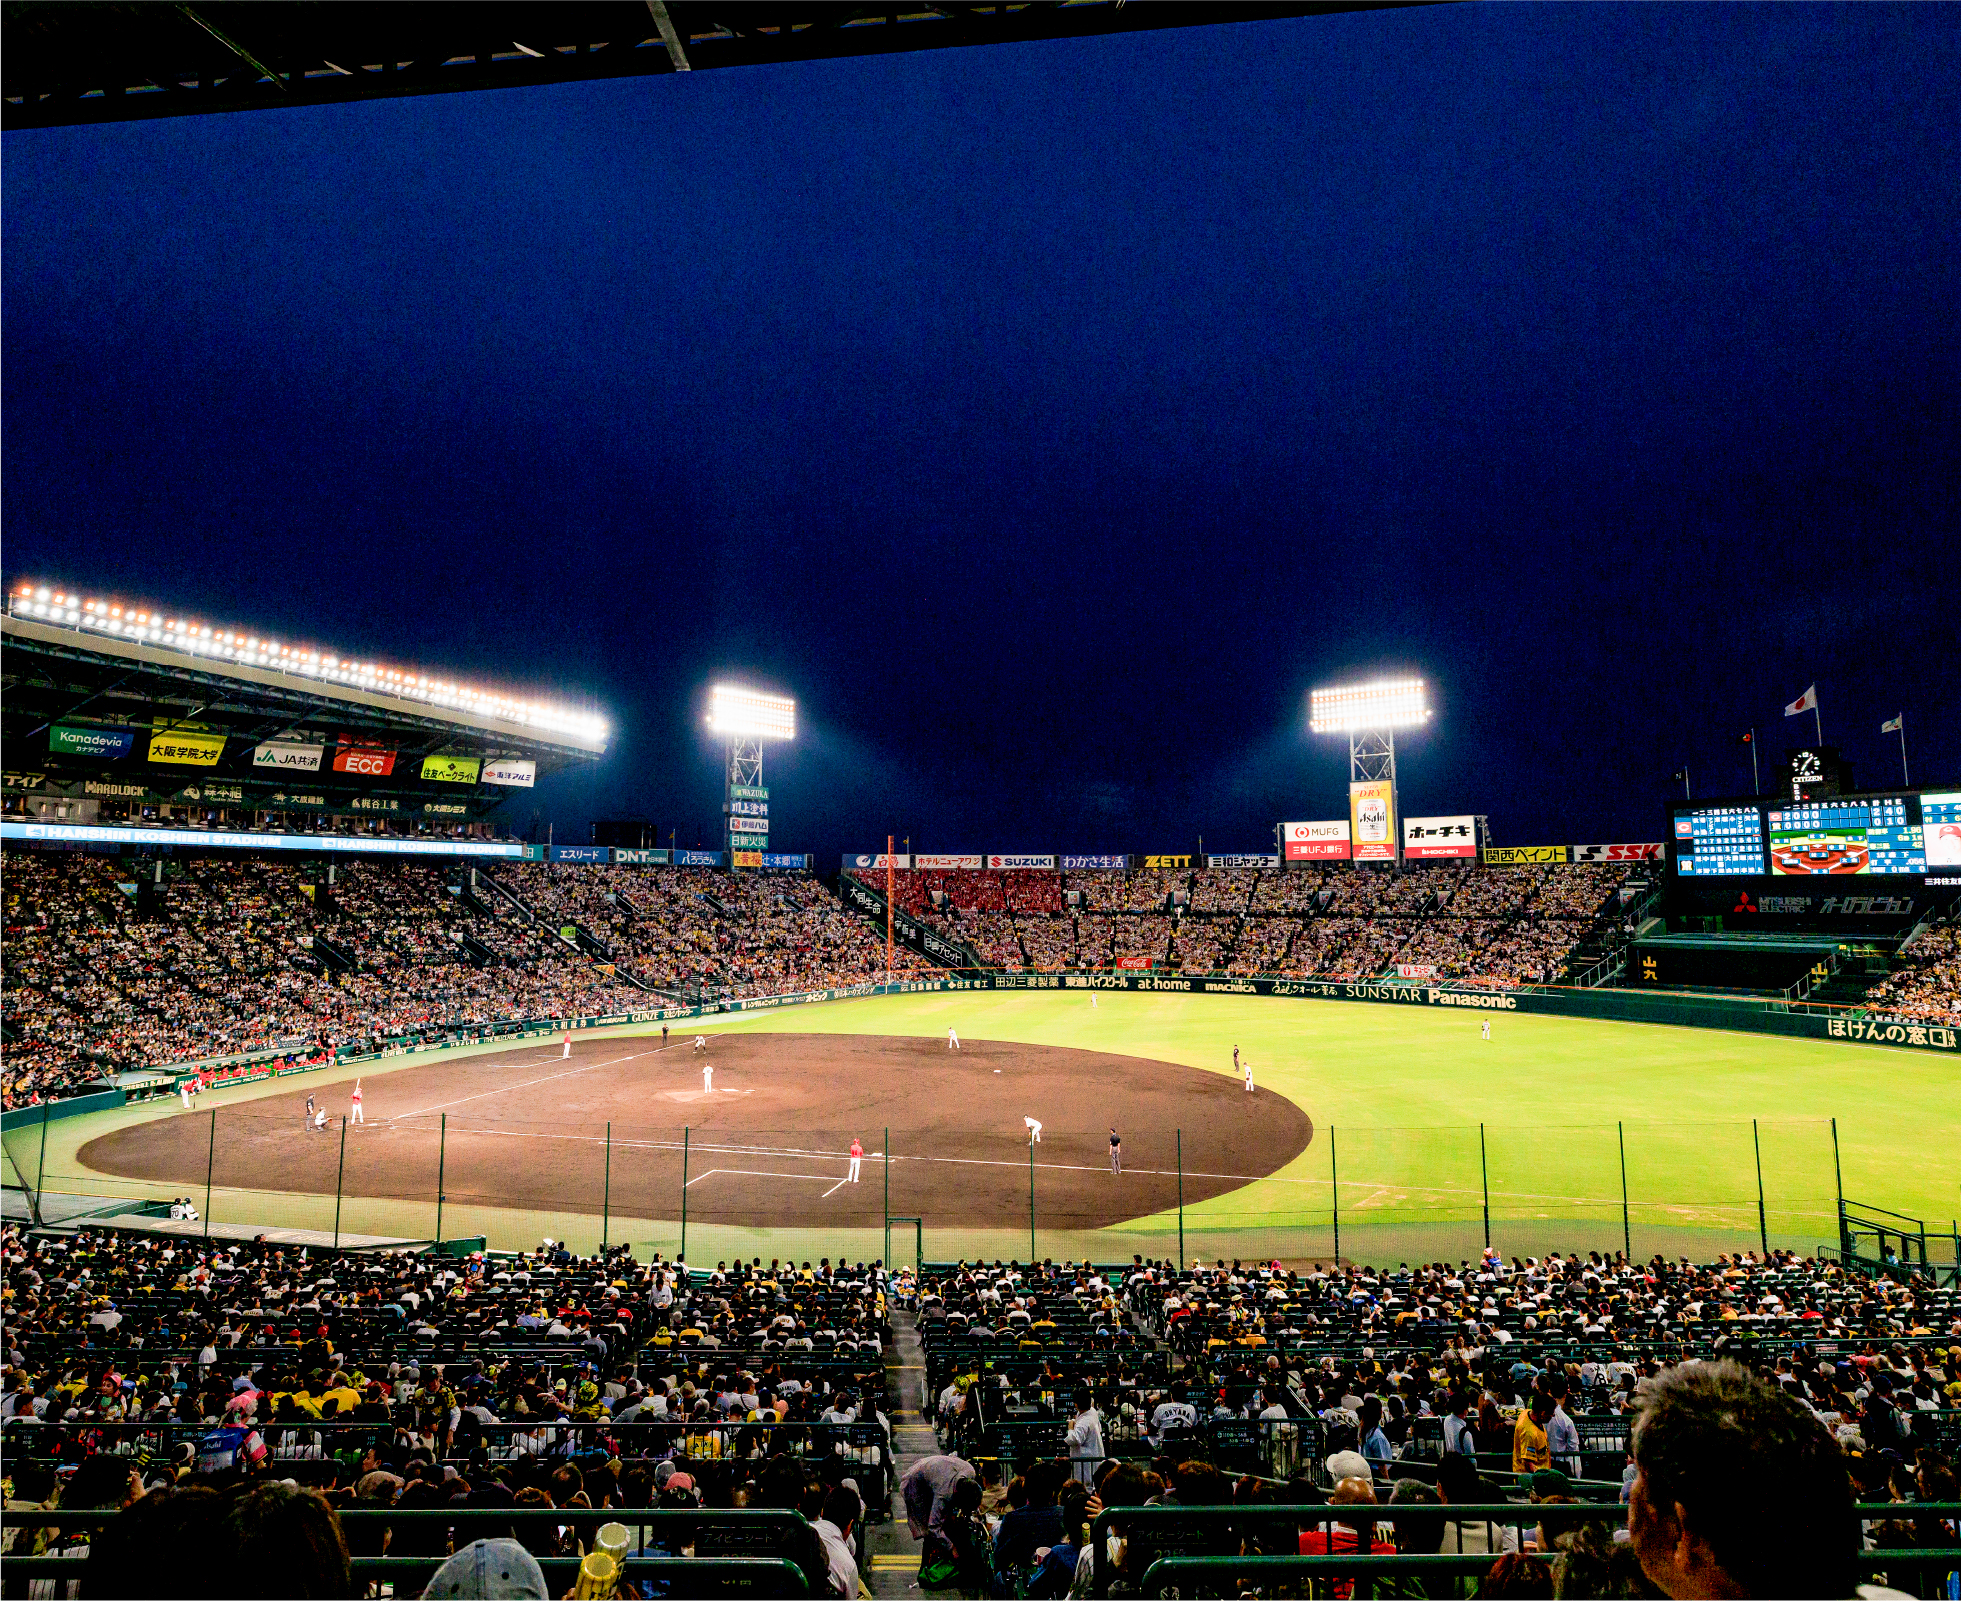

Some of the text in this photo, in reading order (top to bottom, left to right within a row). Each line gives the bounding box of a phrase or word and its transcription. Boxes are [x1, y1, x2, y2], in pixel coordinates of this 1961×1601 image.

[60, 731, 122, 747] Kanadevia
[152, 745, 219, 761] 大阪学院大学
[279, 755, 318, 767] JA共済
[345, 757, 383, 774] ECC
[423, 767, 475, 782] 住友ベークライト
[85, 780, 145, 797] HARDLOCK
[204, 785, 242, 799] 森本組
[741, 788, 768, 799] WAZUKA
[732, 802, 768, 816] 川上塗料
[1793, 812, 1800, 820] 0
[1873, 808, 1880, 816] 2
[1885, 807, 1893, 815] 4
[1360, 811, 1385, 823] Asahi
[1785, 822, 1792, 830] 0
[1793, 821, 1800, 829] 0
[1813, 820, 1820, 828] 0
[1874, 818, 1881, 826] 0
[1886, 817, 1893, 825] 1
[47, 827, 281, 847] HANSHIN KOSHIEN STADIUM
[1311, 827, 1339, 837] MUFG
[1409, 824, 1470, 839] ホーチキ
[337, 839, 506, 855] HANSHIN KOSHIEN STADIUM
[732, 835, 767, 847] 日新火災
[560, 850, 600, 860] エスリード
[615, 850, 649, 862] DNT
[1293, 845, 1342, 855] 三菱UFJ銀行
[1485, 848, 1565, 862] 関西ペイント
[1606, 844, 1661, 860] SSK
[690, 855, 716, 865] ろうきん
[917, 856, 981, 867] ホテルニューアワジ
[1004, 857, 1052, 867] SUZUKI
[1063, 855, 1125, 868] わかさ生活
[1144, 854, 1192, 868] ZETT
[850, 887, 881, 914] 大同生命
[1758, 897, 1812, 905] MITSUBISHI
[1759, 905, 1805, 913] ELECTRIC
[995, 976, 1059, 988] 田辺三菱製薬
[1065, 975, 1129, 988] 東進ハイスクール
[1137, 977, 1191, 991] at home
[1346, 985, 1421, 1002] SUNSTAR
[1428, 988, 1517, 1009] Panasonic
[632, 1012, 659, 1023] GUNZE
[551, 1021, 587, 1030] 大和証券
[1827, 1019, 1949, 1048] ほけんの窓口
[704, 1533, 772, 1543] アイビーシート
[1135, 1530, 1204, 1540] アイビーシート
